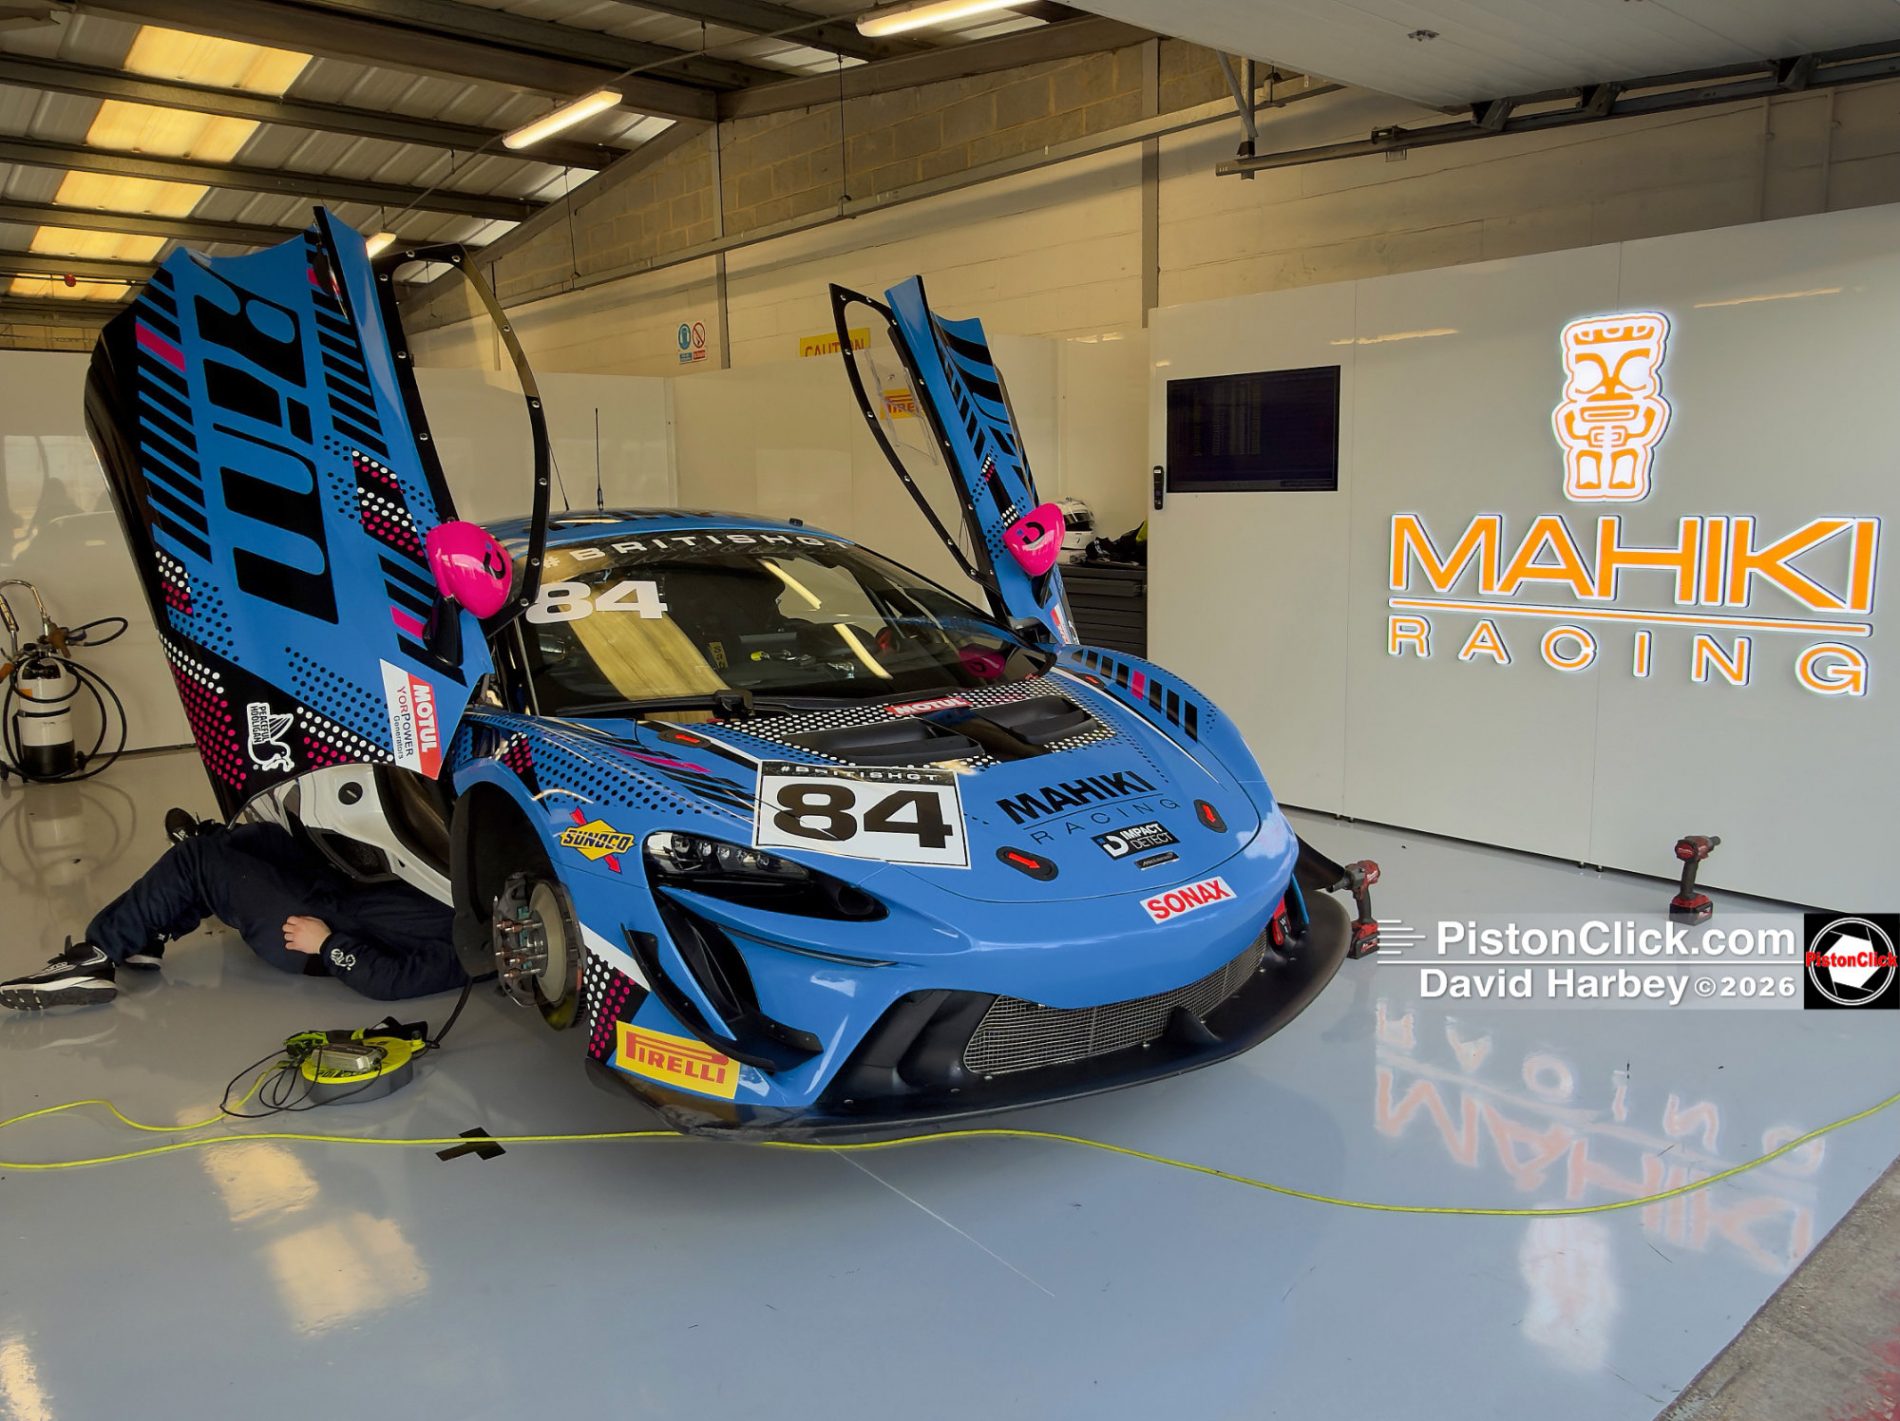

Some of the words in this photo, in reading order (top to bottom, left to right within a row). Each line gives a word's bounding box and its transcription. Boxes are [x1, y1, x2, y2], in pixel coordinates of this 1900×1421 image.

[1389, 514, 1880, 614] MAHIKI
[525, 580, 668, 624] 84
[1388, 615, 1868, 696] RACING
[250, 705, 262, 743] HOOLIGAN
[259, 705, 270, 740] PEACEFUL
[412, 684, 438, 753] MOTUL
[894, 698, 967, 715] MOTUL
[773, 783, 953, 849] 84
[995, 770, 1158, 825] MAHIKI
[562, 831, 632, 851] SUNOCO
[1029, 798, 1181, 845] RACING
[1119, 822, 1164, 841] IMPACT
[1130, 832, 1174, 850] DETECT
[1147, 879, 1231, 920] SONAX
[625, 1030, 730, 1085] PIRELLI
